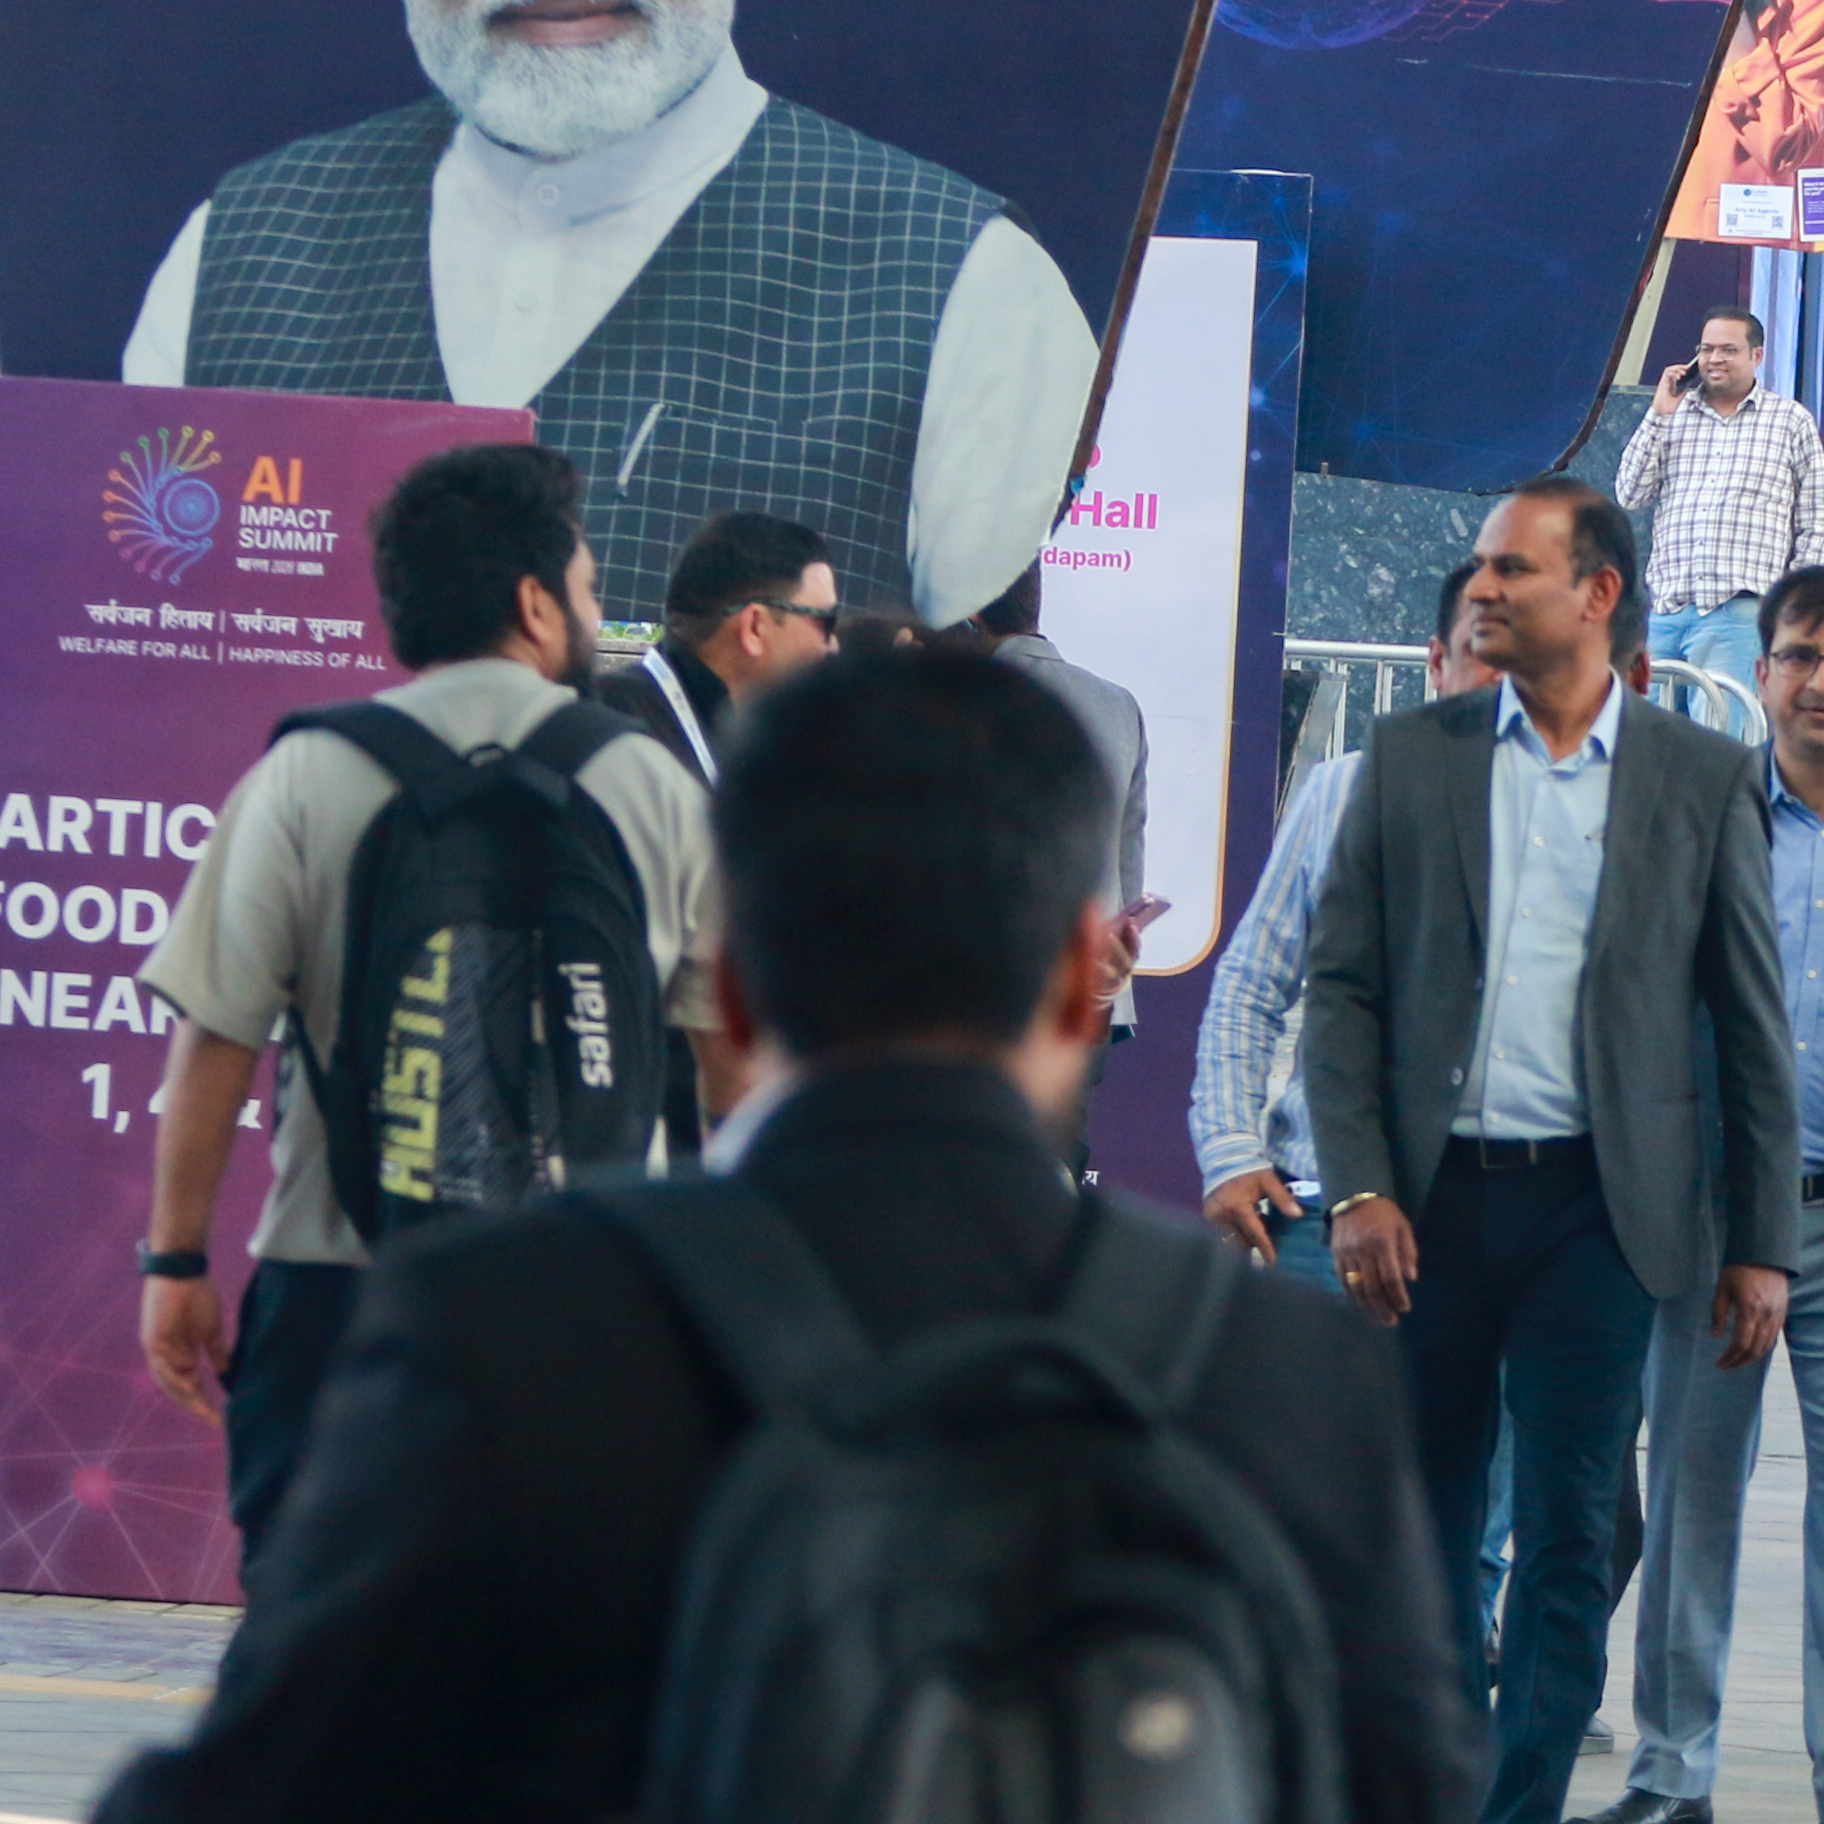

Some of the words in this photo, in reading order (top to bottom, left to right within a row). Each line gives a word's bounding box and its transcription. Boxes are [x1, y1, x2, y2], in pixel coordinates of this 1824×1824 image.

[242, 455, 302, 505] AI
[240, 504, 332, 530] IMPACT
[1070, 491, 1158, 529] Hall
[238, 527, 339, 553] SUMMIT
[58, 635, 137, 659] WELFARE
[141, 640, 178, 661] FOR
[181, 642, 211, 663] ALL
[229, 646, 325, 667] HAPPINESS
[327, 651, 352, 670] OF
[355, 654, 388, 671] ALL
[0, 880, 171, 946] OOD
[558, 961, 614, 1090] safari
